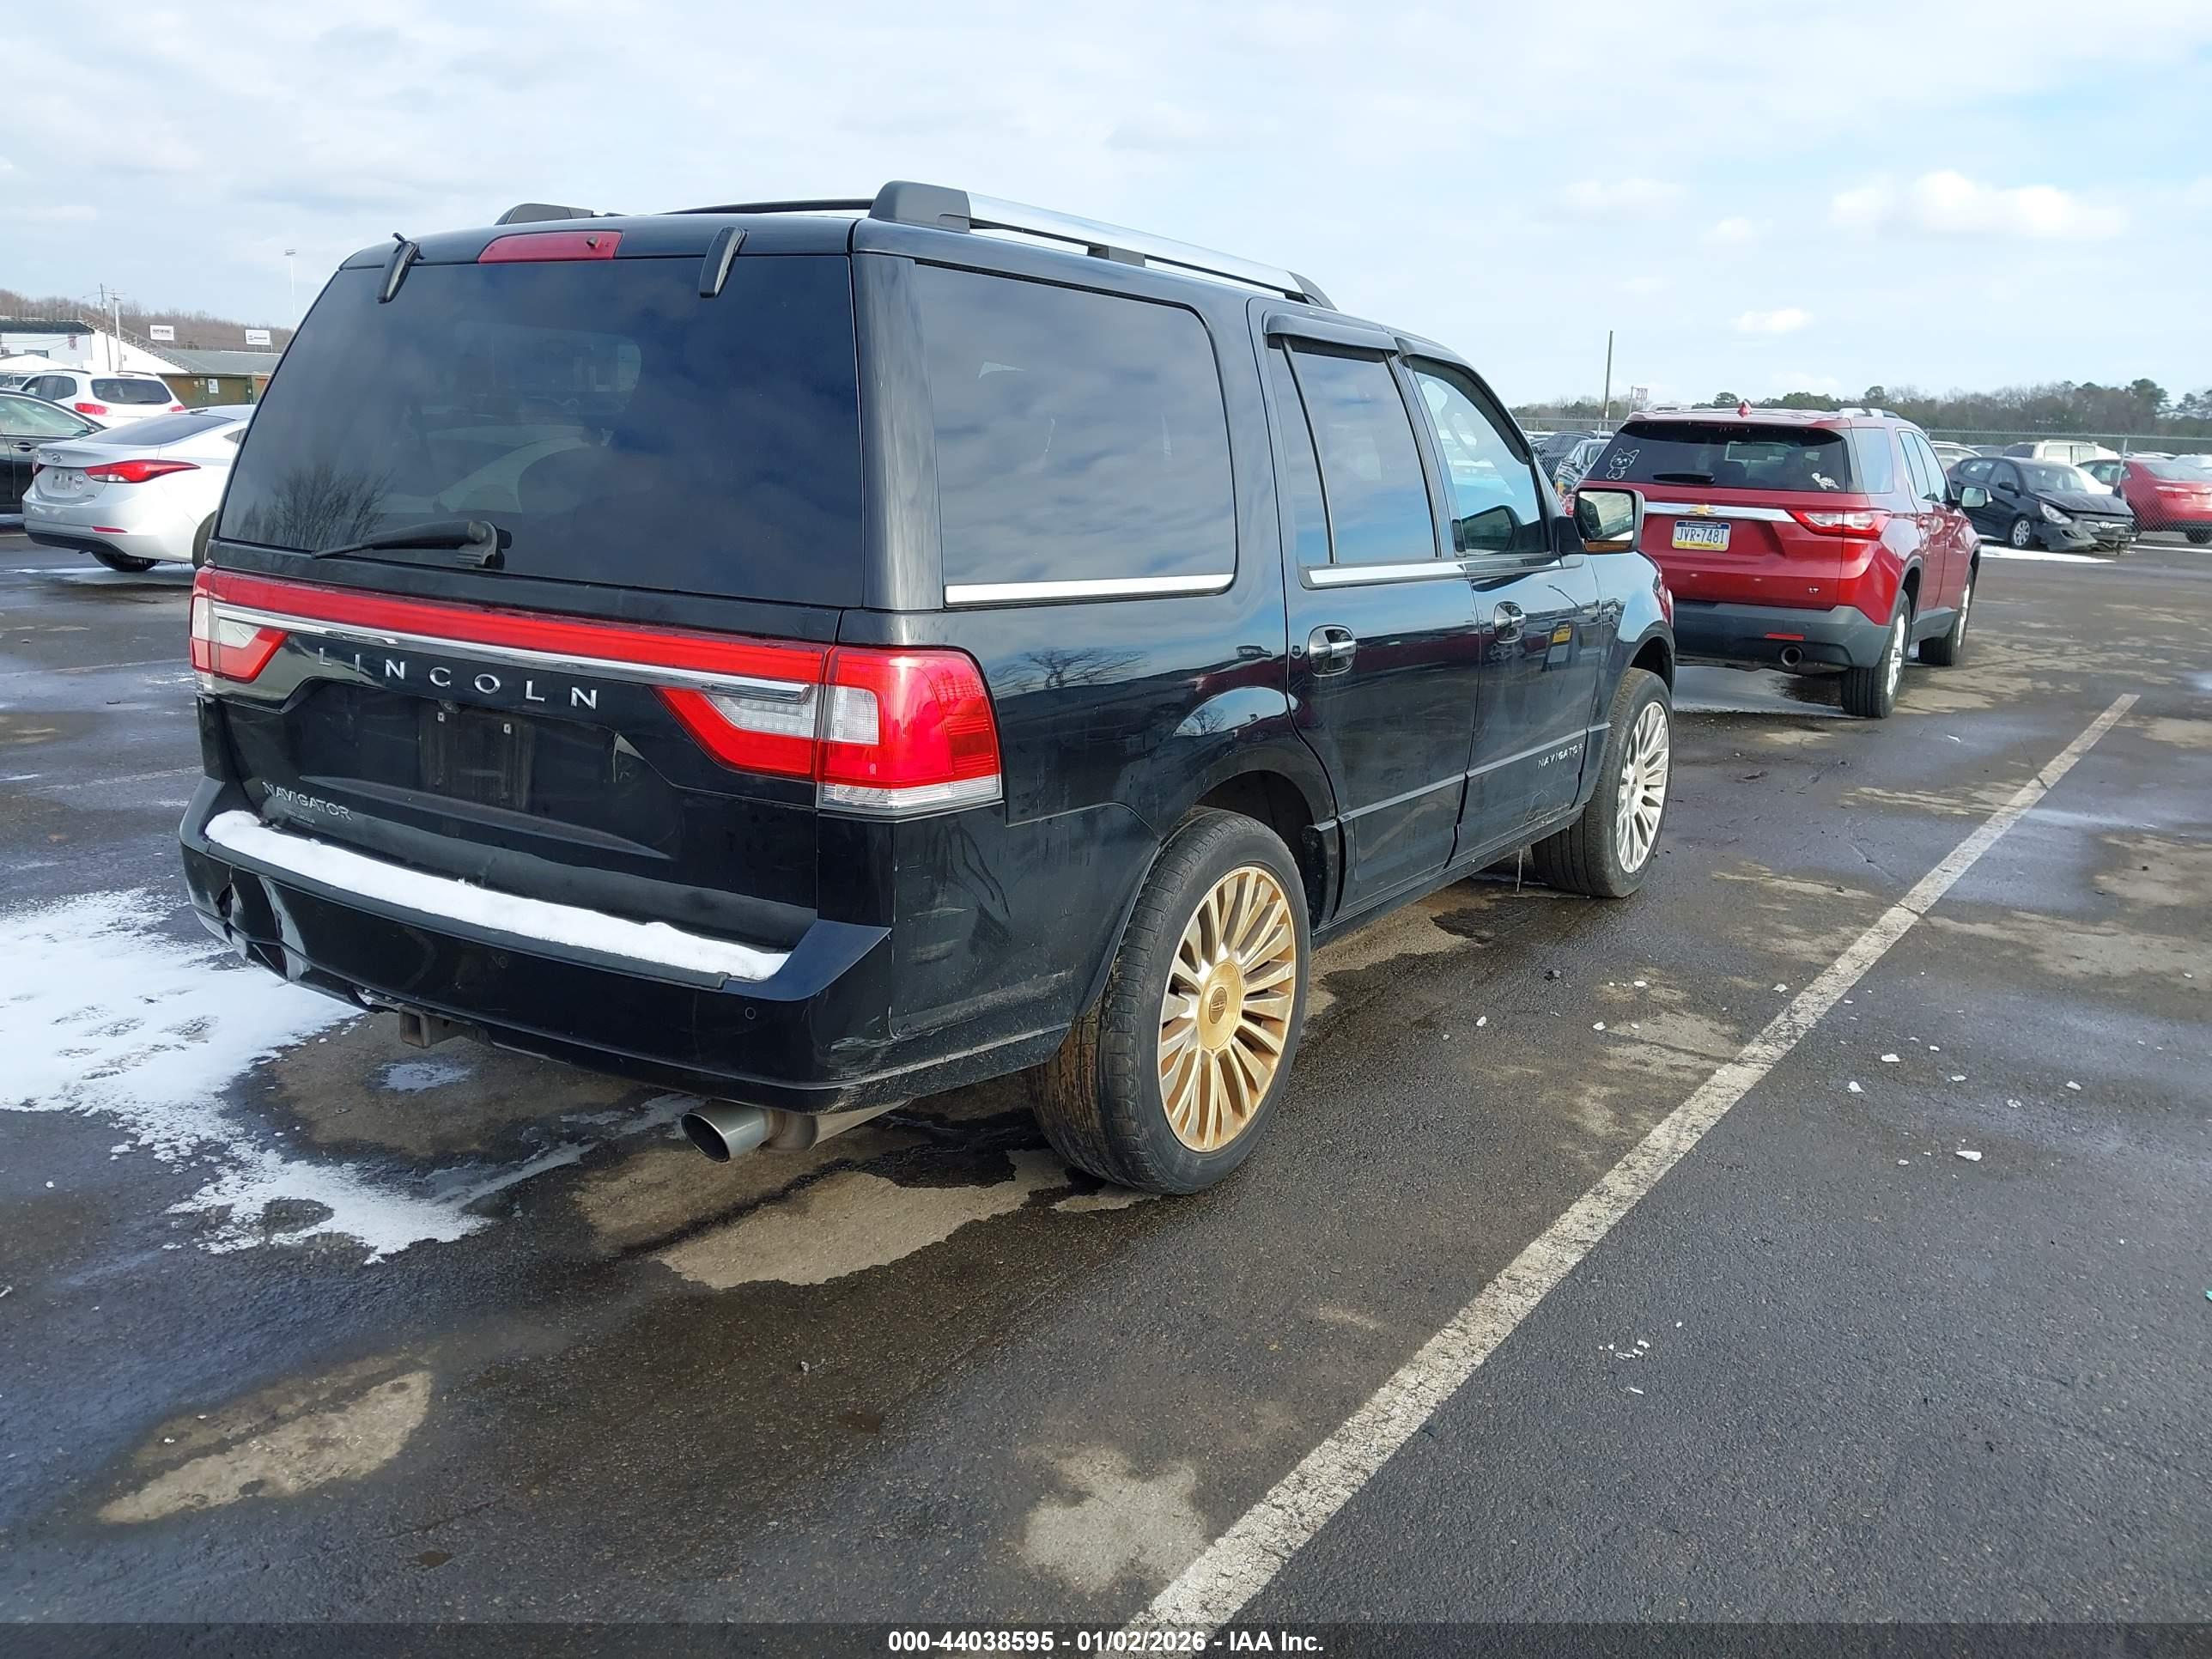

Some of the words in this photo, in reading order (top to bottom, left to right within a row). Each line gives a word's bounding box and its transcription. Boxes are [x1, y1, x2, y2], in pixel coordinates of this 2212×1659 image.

[319, 647, 598, 710] LINCOLN
[1538, 743, 1583, 770] NAVIGATOR
[261, 781, 353, 822] NAVIGATOR
